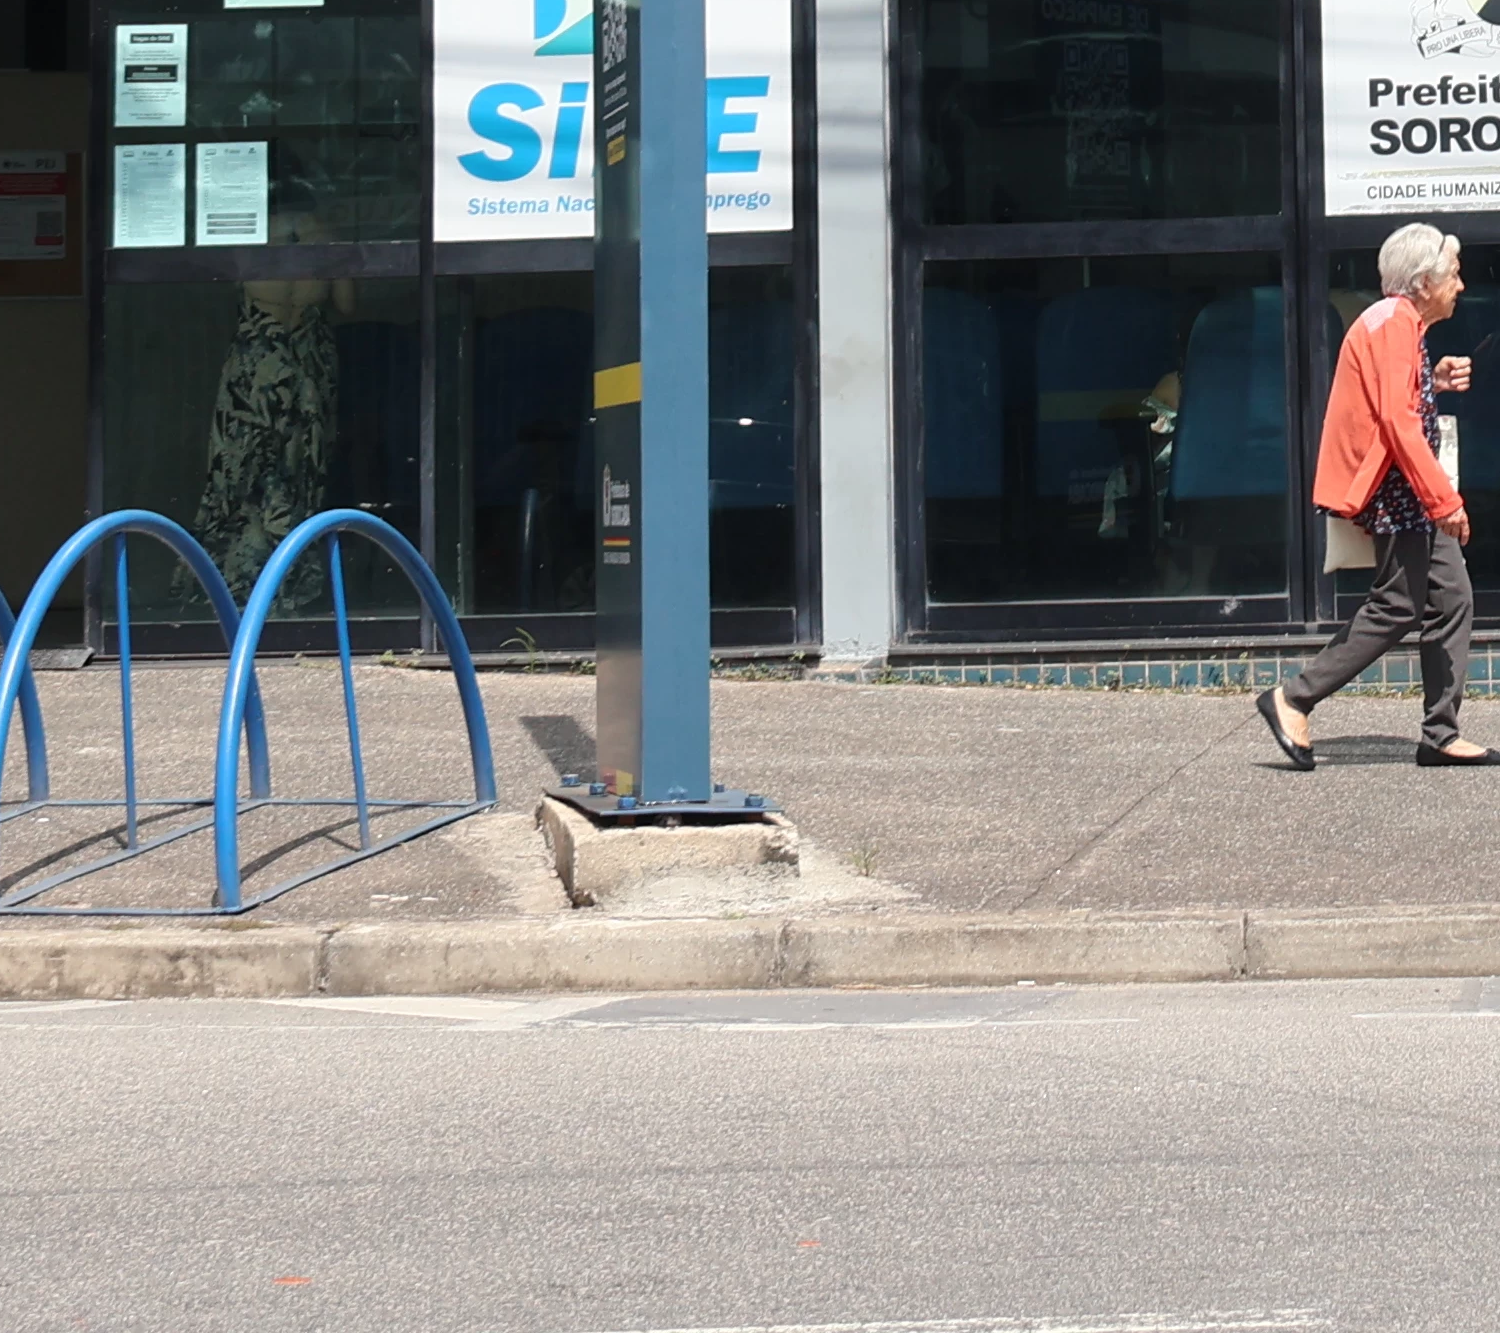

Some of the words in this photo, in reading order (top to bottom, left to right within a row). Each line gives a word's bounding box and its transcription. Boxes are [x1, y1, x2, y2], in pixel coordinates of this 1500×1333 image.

[1426, 41, 1443, 55] PRO
[1443, 34, 1460, 48] UNA
[1460, 26, 1487, 41] LIBERA
[457, 75, 771, 183] SiE
[1366, 182, 1428, 201] CIDADE
[467, 195, 550, 216] Sistema
